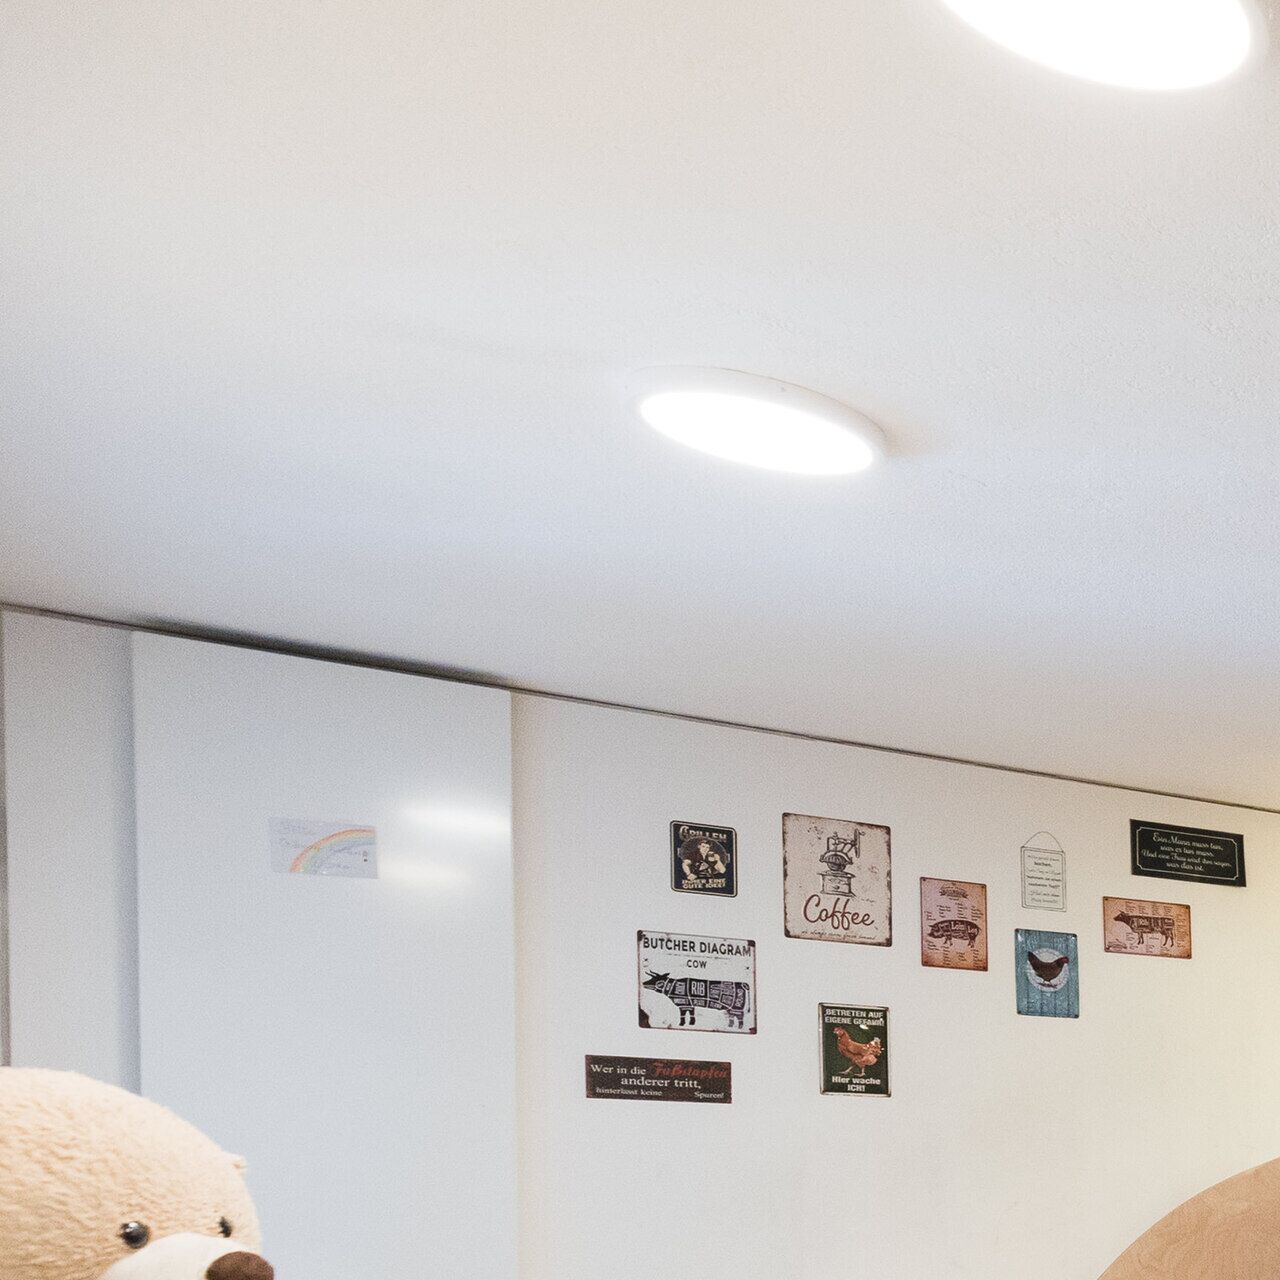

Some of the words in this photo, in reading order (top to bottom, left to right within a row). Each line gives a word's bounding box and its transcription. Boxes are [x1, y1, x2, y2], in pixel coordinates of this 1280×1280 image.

[803, 894, 875, 931] Coffee
[643, 937, 696, 953] BUTCHER
[700, 941, 752, 957] DIAGRAM
[686, 960, 707, 969] COW
[691, 981, 706, 996] RIB
[825, 1008, 867, 1018] BETRETEN
[868, 1011, 884, 1019] AUF
[824, 1016, 852, 1025] EIGENE
[590, 1064, 613, 1074] Wer
[617, 1065, 627, 1074] in
[630, 1066, 646, 1075] die
[621, 1076, 670, 1087] anderer
[674, 1078, 701, 1090] tritt,
[831, 1075, 850, 1084] Hier
[852, 1077, 881, 1085] wache
[640, 1088, 663, 1096] keine
[847, 1084, 865, 1092] ICH!
